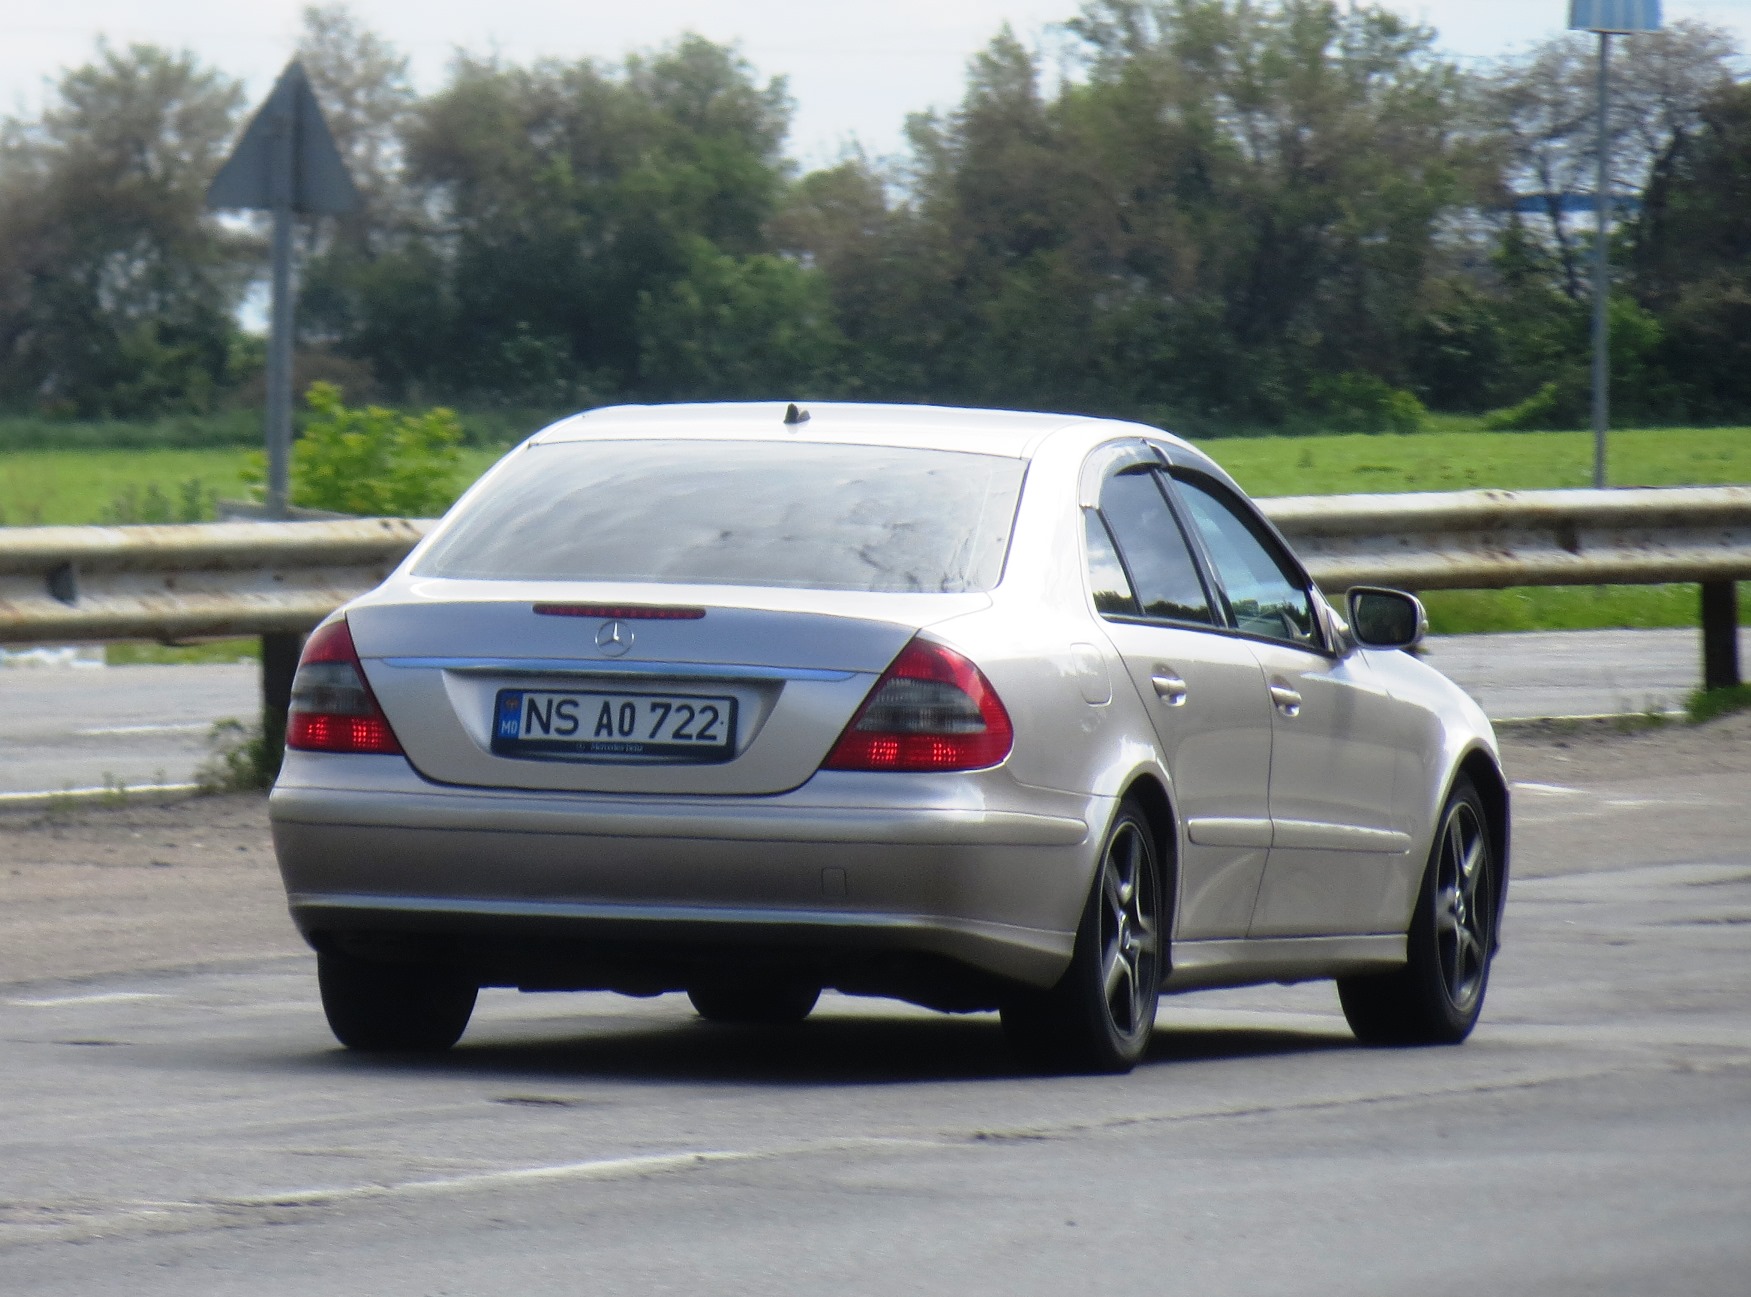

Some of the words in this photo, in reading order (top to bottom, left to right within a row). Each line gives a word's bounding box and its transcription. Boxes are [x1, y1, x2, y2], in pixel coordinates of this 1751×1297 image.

[501, 720, 518, 734] MD
[525, 698, 580, 736] NS
[649, 702, 719, 741] 722
